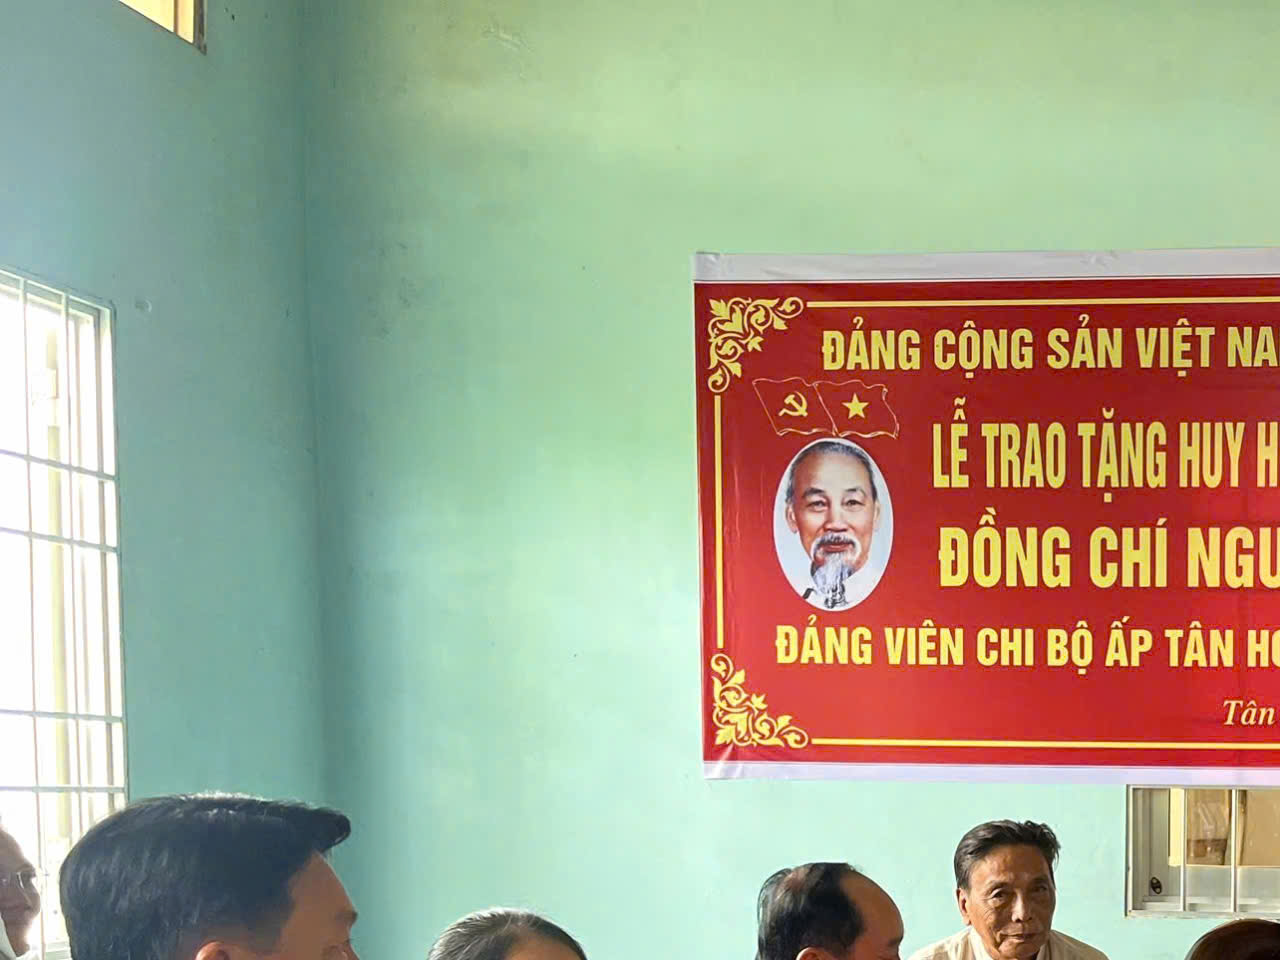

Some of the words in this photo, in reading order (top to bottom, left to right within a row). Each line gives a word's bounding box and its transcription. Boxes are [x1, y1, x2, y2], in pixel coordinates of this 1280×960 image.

[821, 316, 921, 371] ĐẢNG
[933, 320, 1033, 379] CỘNG
[1047, 313, 1123, 370] SẢN
[1135, 317, 1216, 377] VIỆT
[932, 396, 970, 488] LỄ
[981, 421, 1066, 489] TRAO
[1077, 407, 1167, 503] TẶNG
[1179, 421, 1246, 489] HUY
[938, 506, 1071, 588] ĐỒNG
[1089, 517, 1168, 589] CHÍ
[774, 613, 873, 666] ĐẢNG
[883, 618, 964, 666] VIÊN
[976, 627, 1034, 667] CHI
[1050, 620, 1093, 675] BỘ
[1104, 615, 1153, 667] ẤP
[1164, 620, 1234, 668] TÂN
[1223, 699, 1275, 726] Tân
